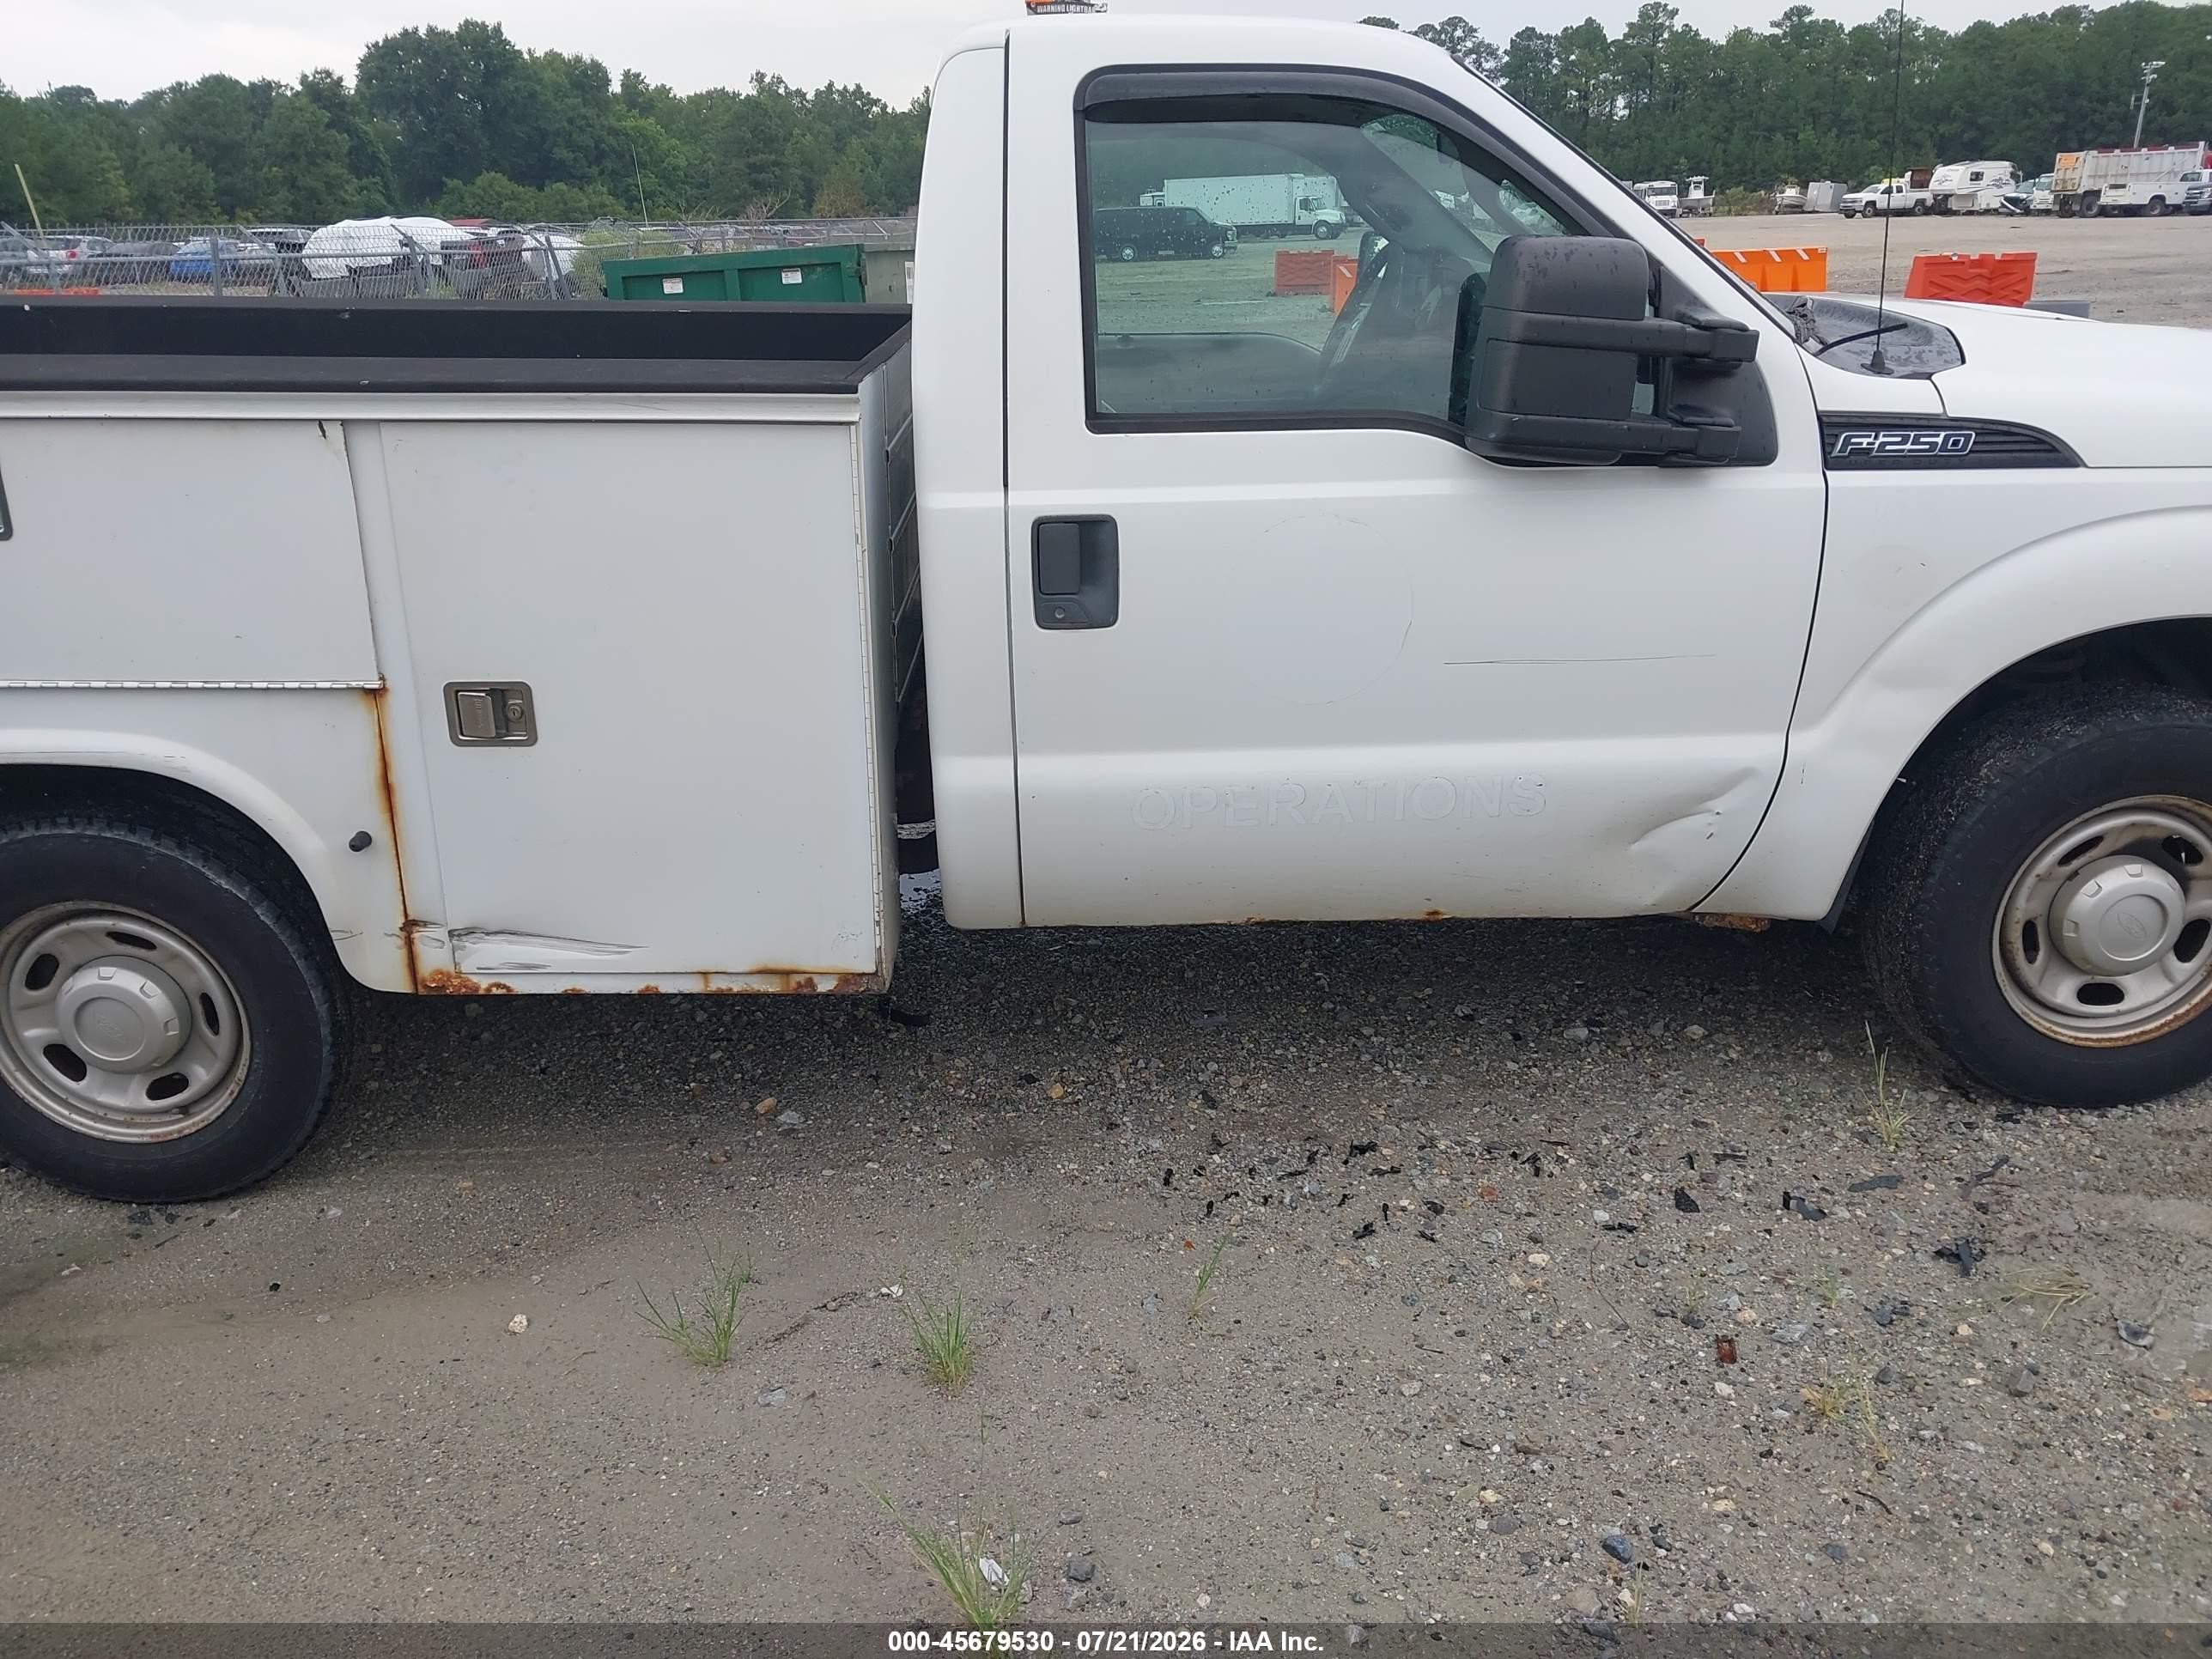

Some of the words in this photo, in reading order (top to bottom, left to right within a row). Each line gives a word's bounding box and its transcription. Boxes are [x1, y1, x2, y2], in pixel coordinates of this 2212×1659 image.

[1036, 4, 1065, 13] WARNING
[1831, 431, 1976, 457] F-250
[1130, 773, 1547, 831] OPERATIONS
